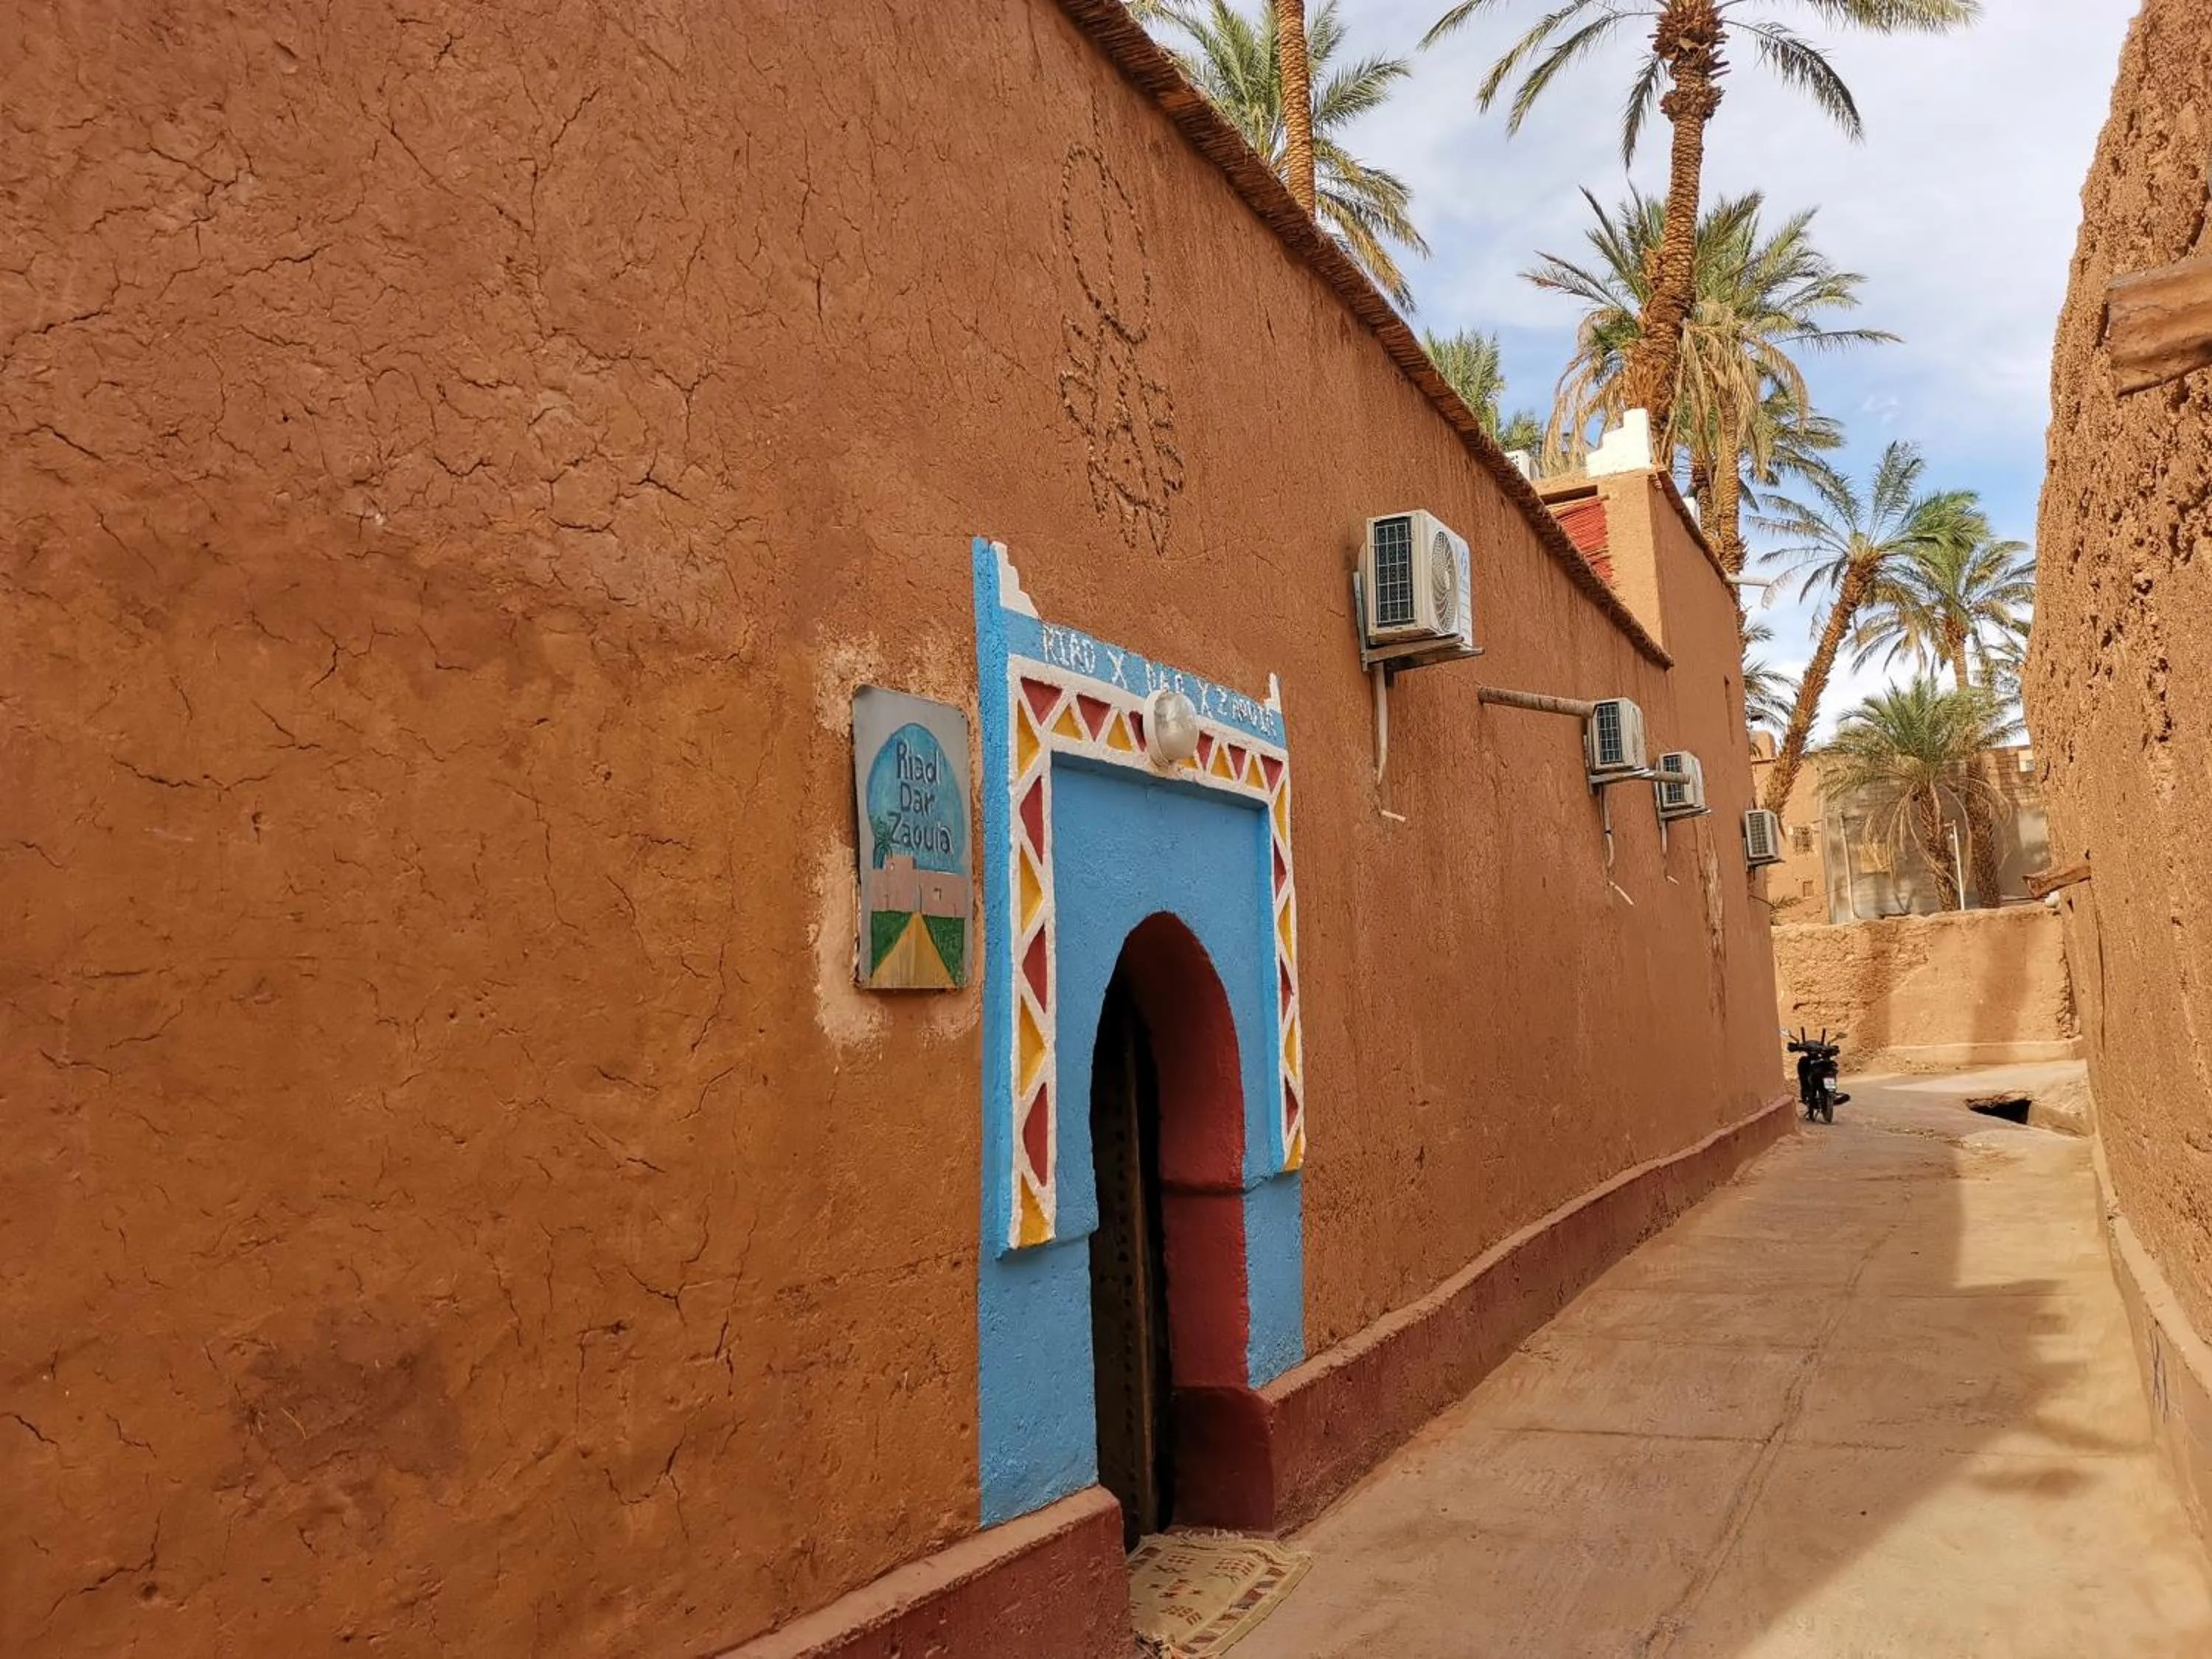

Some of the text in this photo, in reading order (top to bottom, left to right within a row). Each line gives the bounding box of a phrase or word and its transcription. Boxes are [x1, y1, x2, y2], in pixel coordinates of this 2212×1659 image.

[897, 739, 940, 785] Riad
[900, 781, 936, 816] Dar
[886, 811, 954, 856] Zaouia
